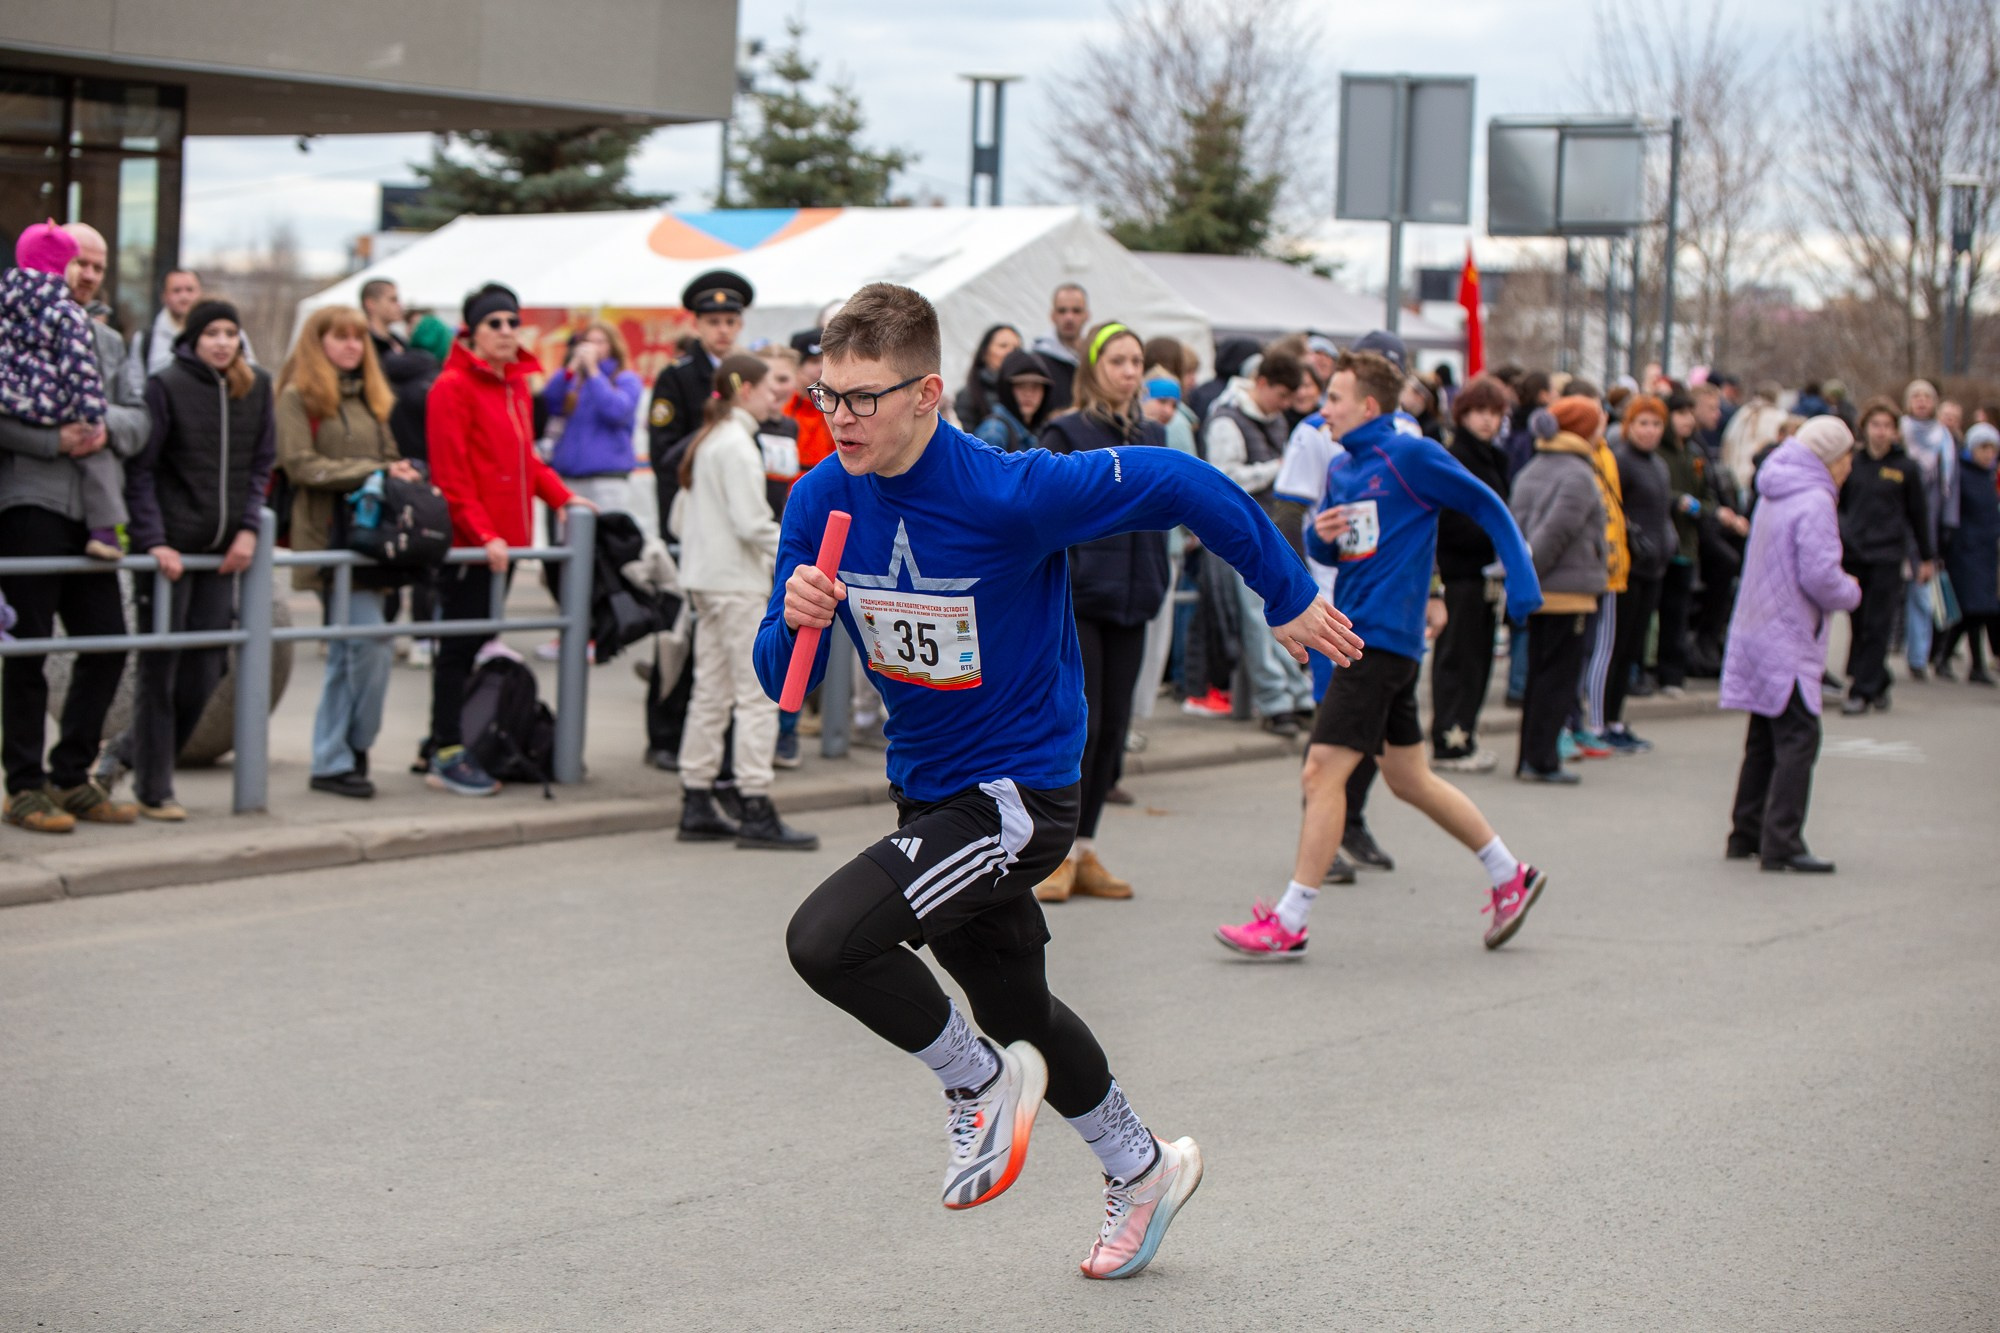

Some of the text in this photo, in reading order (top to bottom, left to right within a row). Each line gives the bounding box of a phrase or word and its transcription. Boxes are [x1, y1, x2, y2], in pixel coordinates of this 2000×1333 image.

[860, 598, 894, 606] ТРАДИЦИОННАЯ
[896, 601, 942, 611] ЛЕГКОАТЛЕТИЧЕСКАЯ
[894, 620, 939, 666] 35
